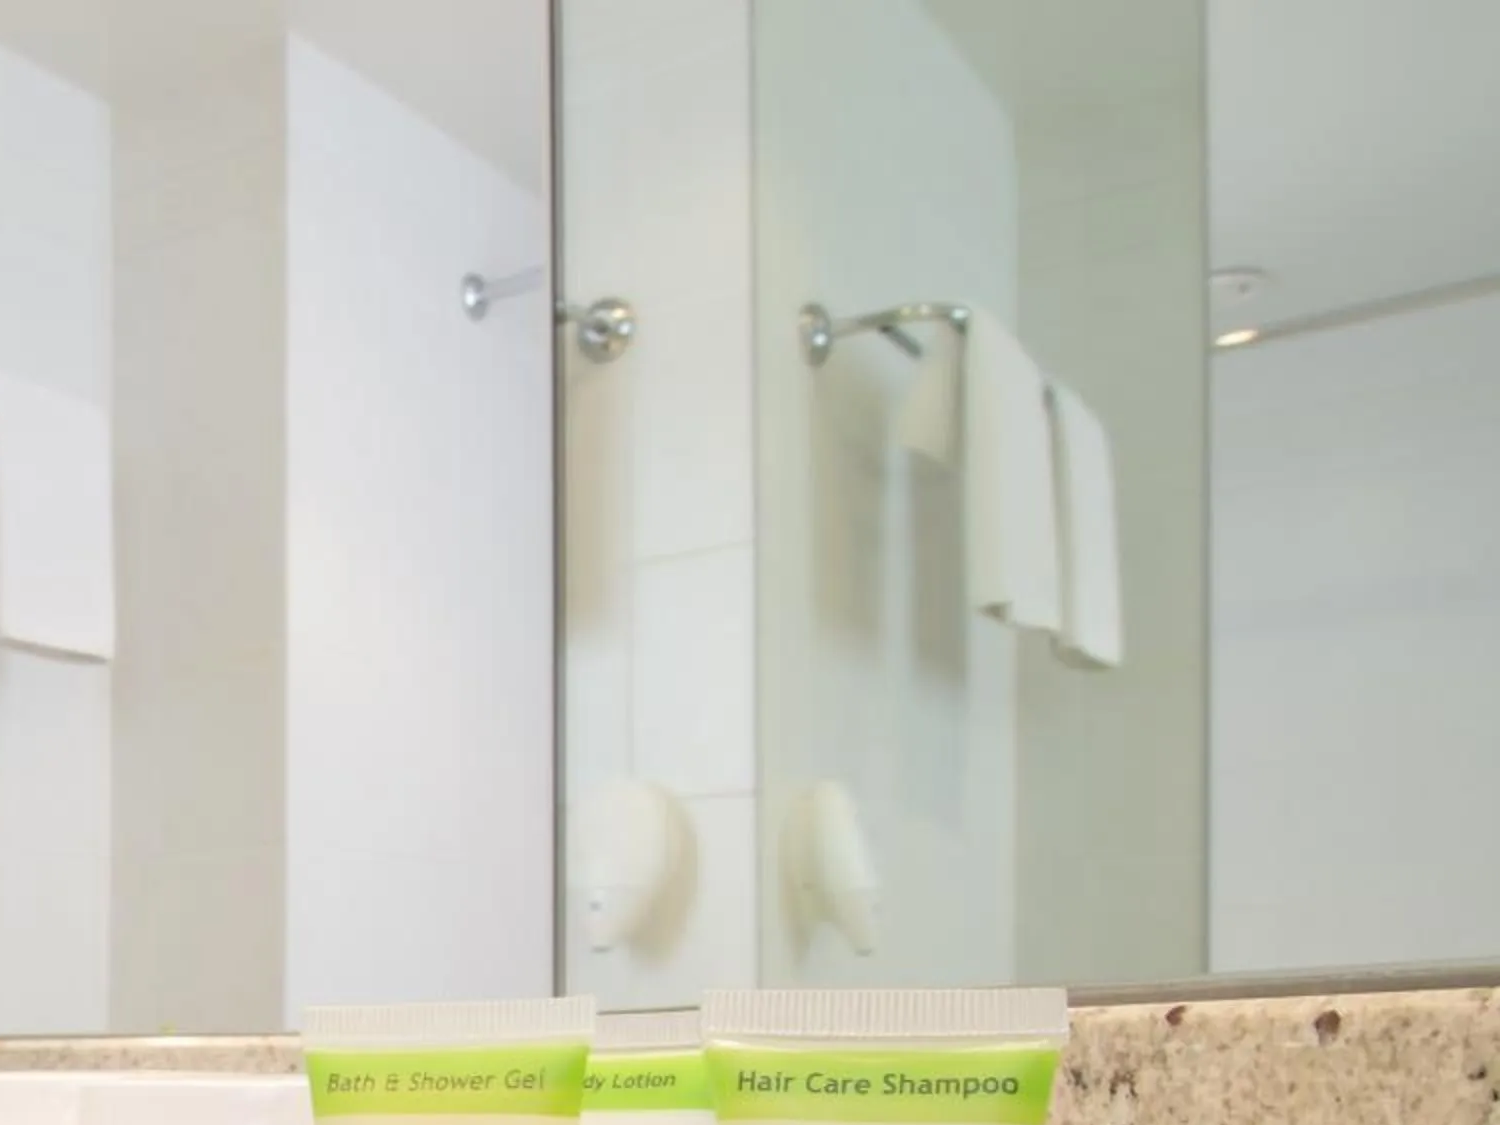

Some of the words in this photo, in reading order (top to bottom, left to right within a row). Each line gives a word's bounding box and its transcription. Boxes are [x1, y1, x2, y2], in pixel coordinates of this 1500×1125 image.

[326, 1072, 376, 1094] Bath
[385, 1072, 401, 1093] &
[408, 1071, 497, 1093] Shower
[504, 1067, 547, 1091] Gel
[582, 1072, 606, 1094] dy
[611, 1071, 677, 1090] Lotion
[737, 1070, 796, 1093] Hair
[805, 1072, 872, 1096] Care
[882, 1073, 1020, 1099] Shampoo
